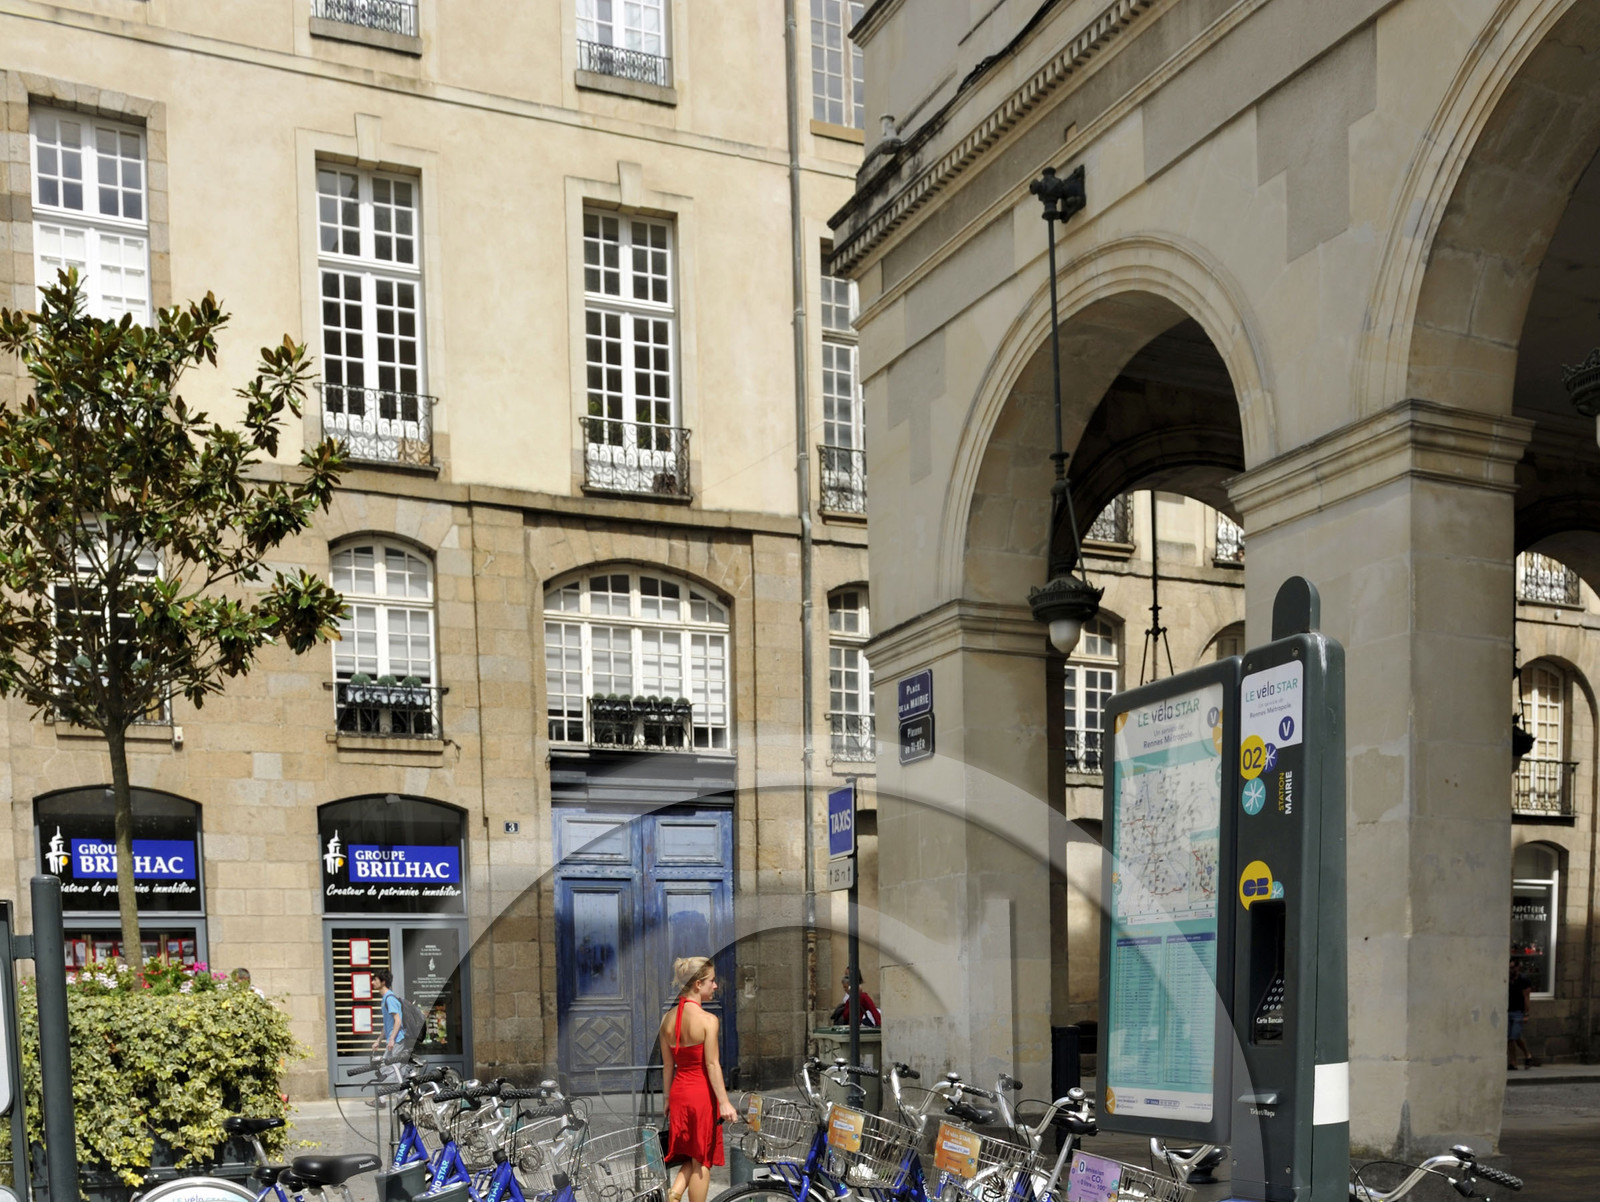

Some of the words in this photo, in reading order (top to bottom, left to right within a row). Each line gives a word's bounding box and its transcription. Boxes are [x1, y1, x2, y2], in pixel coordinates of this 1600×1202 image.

[1246, 691, 1256, 702] LE
[1257, 681, 1275, 700] vélo
[1276, 678, 1299, 694] STAR
[1137, 713, 1149, 728] LE
[1152, 699, 1173, 723] vélo
[1175, 698, 1200, 717] STAR
[1143, 738, 1163, 748] Rennes
[1242, 746, 1263, 771] 02
[1285, 770, 1293, 815] MAIRIE
[508, 822, 516, 832] 3
[830, 808, 852, 835] TAXIS
[79, 855, 184, 874] BRIHAC
[354, 850, 406, 861] GROUPE
[355, 861, 450, 879] BRILHAC
[91, 881, 103, 893] de
[152, 881, 196, 894] immobilier
[366, 885, 377, 896] de
[377, 885, 420, 900] patrimoine
[421, 885, 461, 897] immobilier
[396, 1143, 407, 1162] STAR
[435, 1159, 450, 1180] STAR
